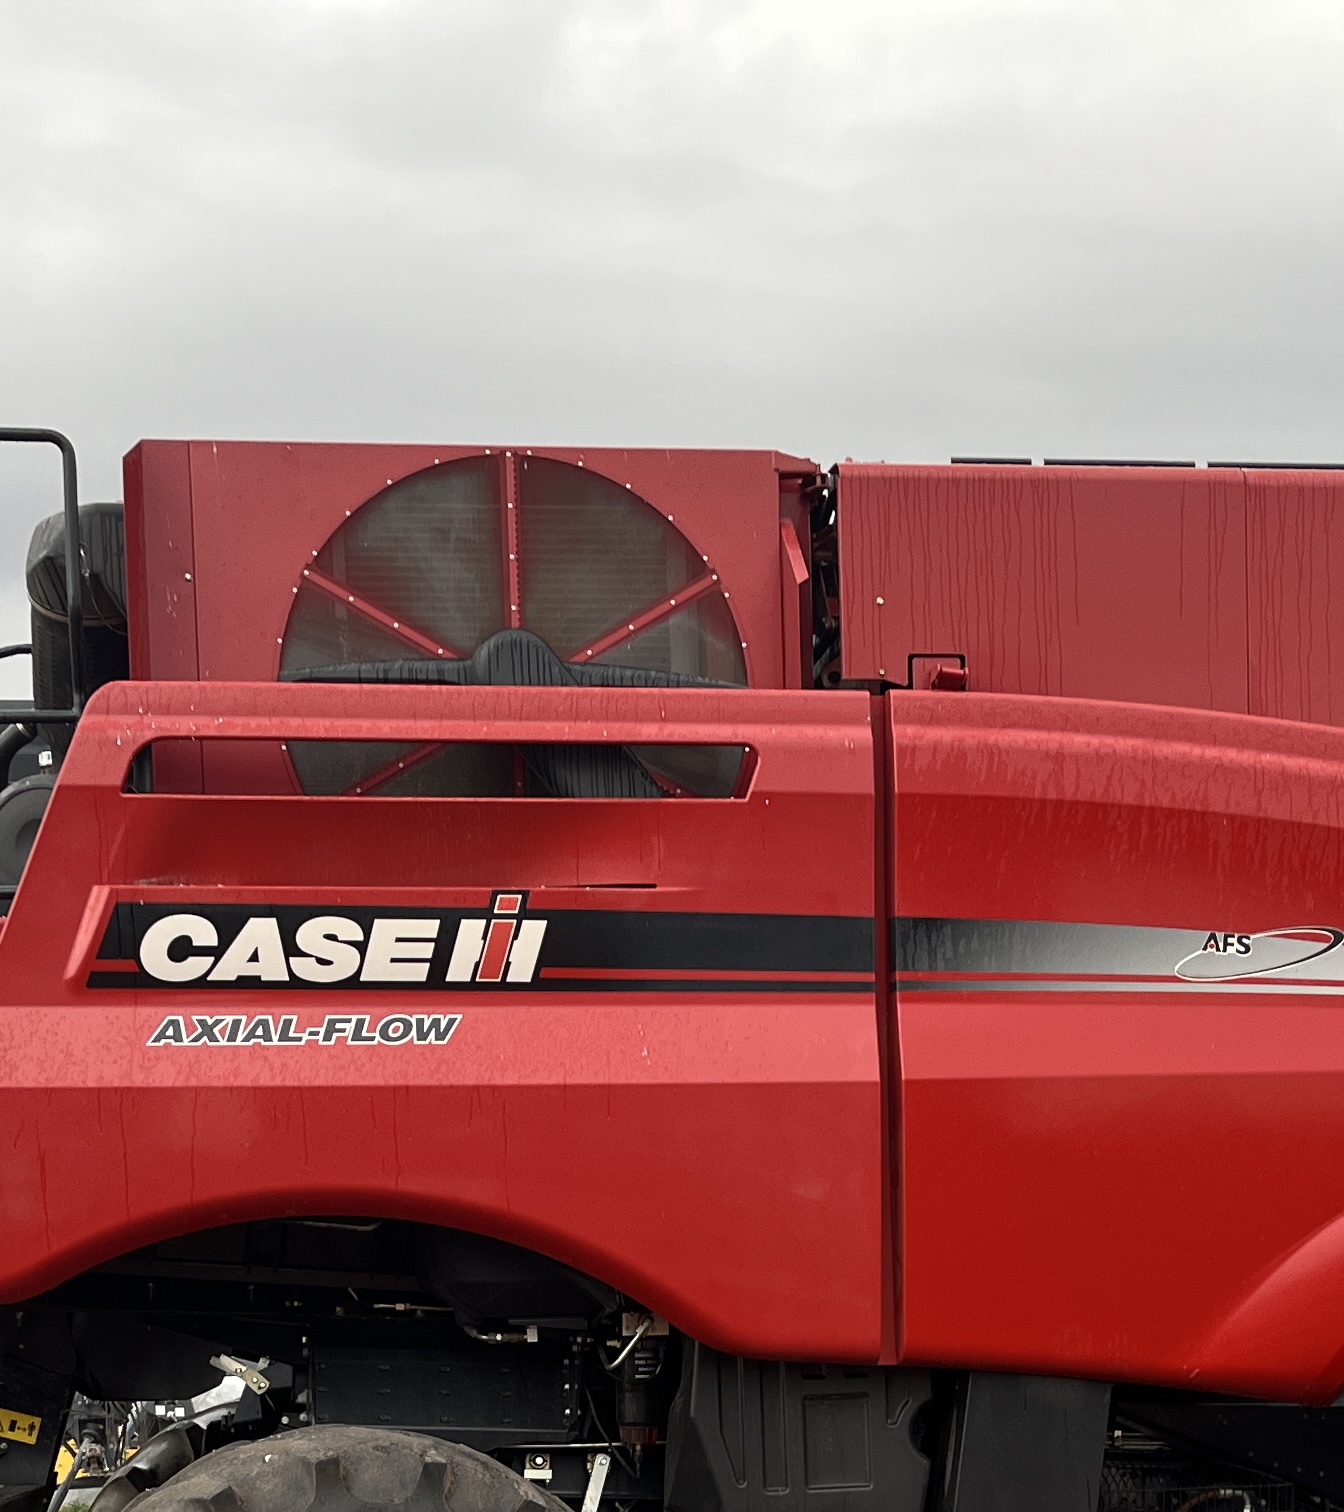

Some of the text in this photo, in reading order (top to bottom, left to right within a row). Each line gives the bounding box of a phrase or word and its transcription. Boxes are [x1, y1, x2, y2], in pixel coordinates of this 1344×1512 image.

[139, 914, 441, 982] CASE
[1201, 931, 1253, 956] AFS
[146, 1012, 462, 1047] AXIAL-FLOW
